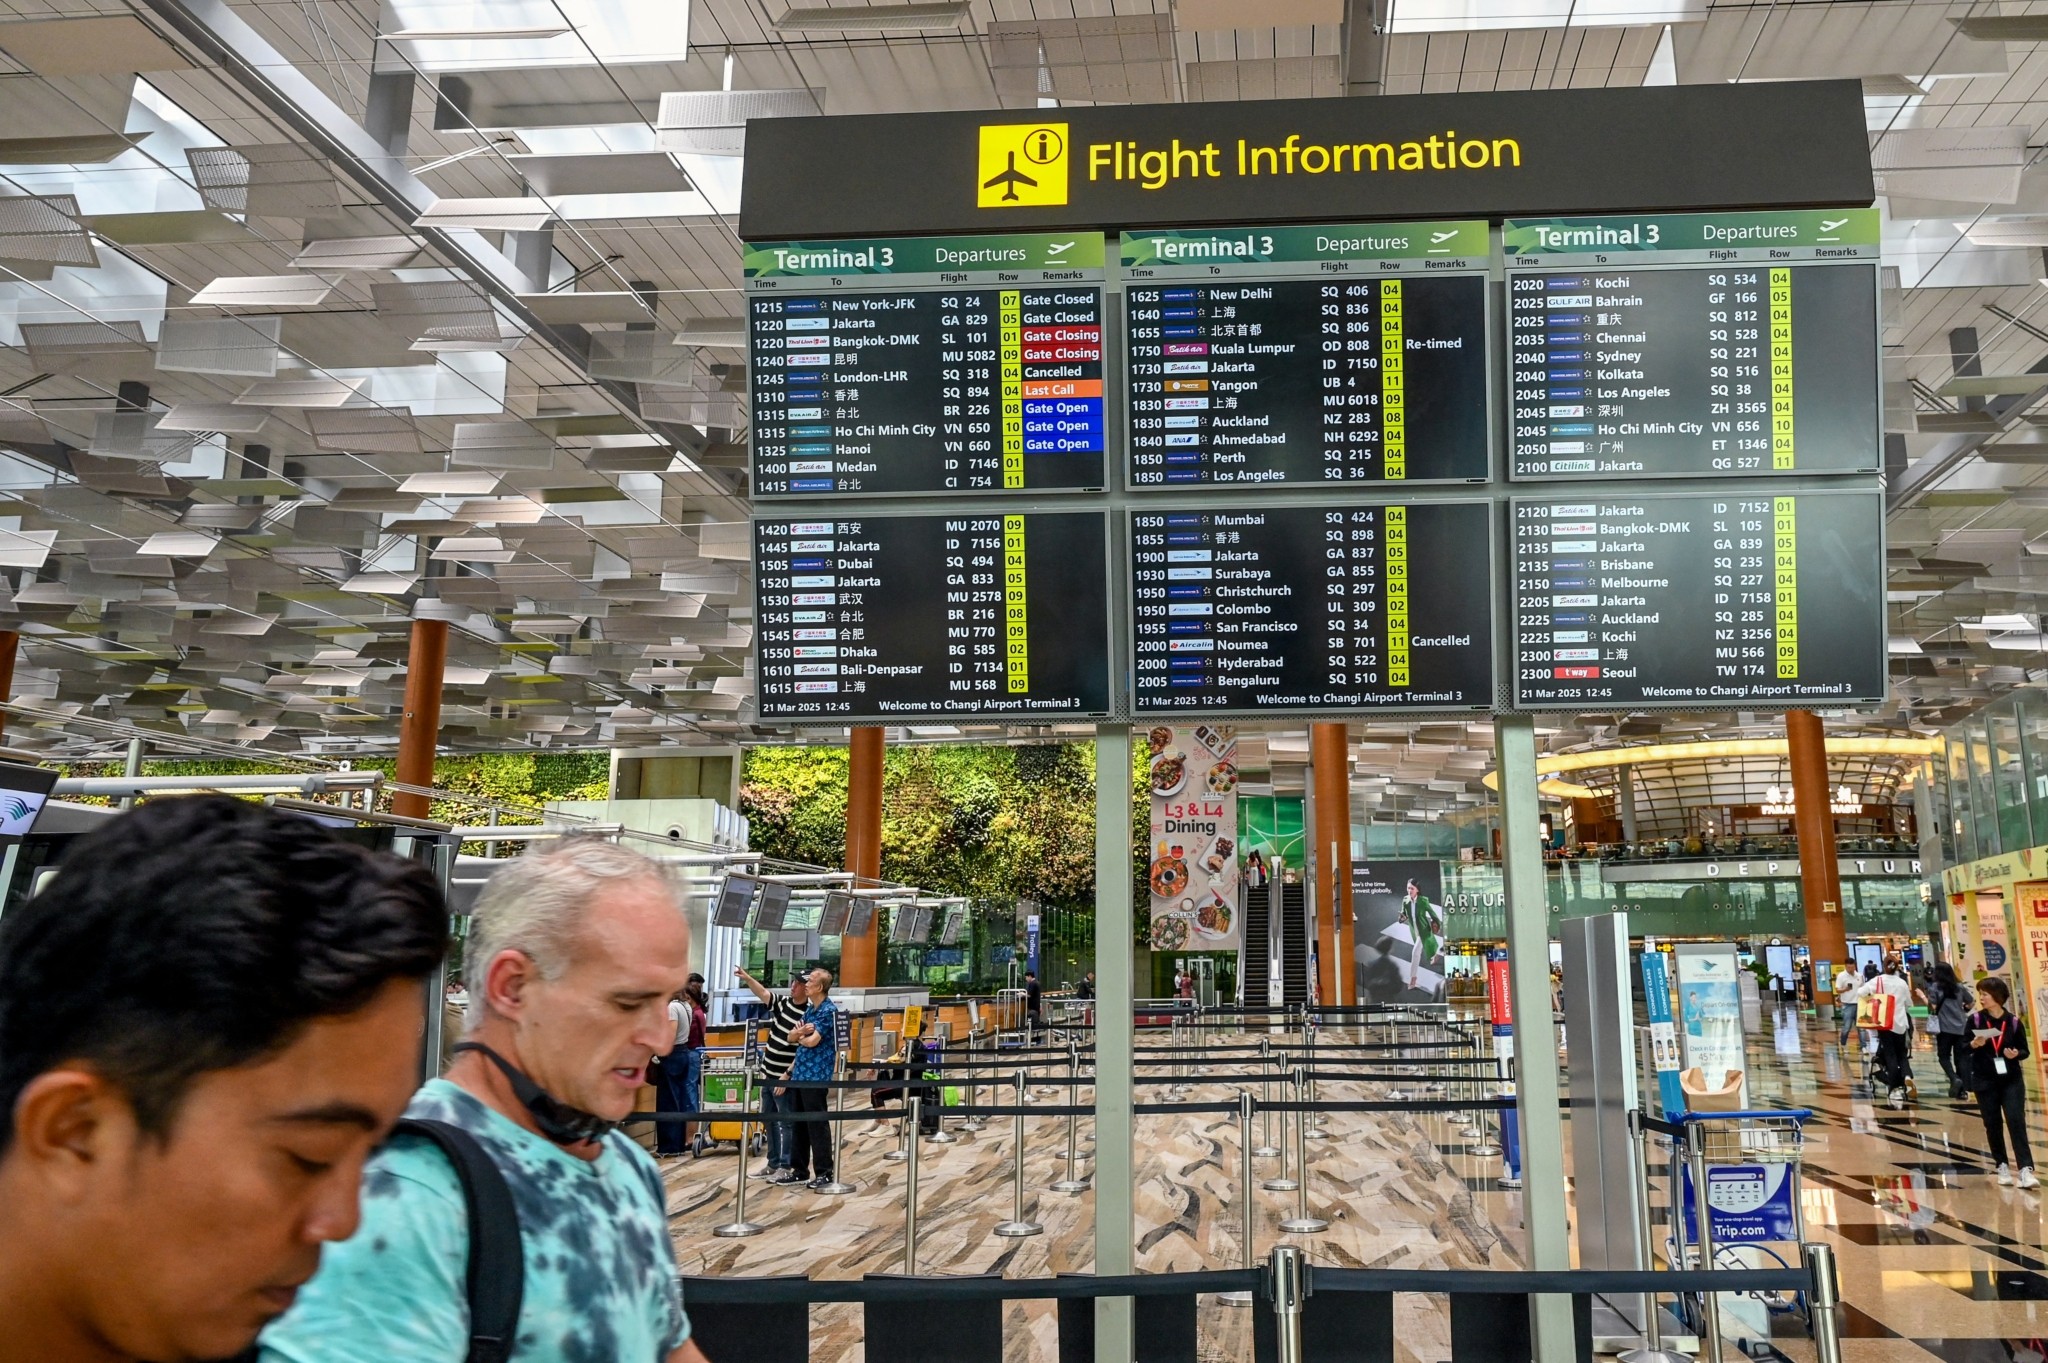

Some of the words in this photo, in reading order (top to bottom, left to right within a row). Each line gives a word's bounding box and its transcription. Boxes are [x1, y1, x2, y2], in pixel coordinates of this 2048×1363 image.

[1090, 140, 1220, 189] Flight
[1238, 131, 1520, 175] Information
[1536, 225, 1640, 247] Terminal
[1647, 225, 1659, 243] 3
[1704, 225, 1797, 242] Departures
[1151, 236, 1253, 258] Terminal
[1261, 236, 1273, 255] 3
[1317, 237, 1408, 254] Departures
[774, 247, 874, 269] Terminal
[881, 248, 893, 266] 3
[936, 248, 1026, 265] Departures
[1515, 257, 1538, 265] Time
[1709, 250, 1737, 260] Flight
[1816, 248, 1857, 256] Remarks
[1321, 261, 1348, 272] Flight
[1425, 259, 1466, 268] Remarks
[754, 280, 776, 288] Time
[941, 273, 967, 283] Flight
[1043, 271, 1083, 279] Remarks
[755, 303, 782, 313] 1215
[833, 301, 859, 310] New
[862, 299, 915, 310] York-JFK
[942, 298, 958, 308] SQ
[966, 297, 980, 307] 24
[1003, 296, 1016, 305] 07
[1023, 295, 1051, 305] Gate
[1054, 293, 1093, 304] Closed
[1514, 298, 1543, 308] 2025
[1596, 295, 1642, 306] Bahrain
[1709, 293, 1725, 303] GF
[1735, 292, 1757, 302] 166
[1773, 292, 1787, 301] 05
[1132, 346, 1160, 356] 1750
[1169, 345, 1189, 353] Batik
[1212, 343, 1244, 354] Kuala
[1249, 343, 1295, 355] Lumpur
[1323, 341, 1341, 351] OD
[1347, 340, 1369, 350] 808
[1385, 340, 1397, 349] 01
[1407, 338, 1461, 349] Re-timed
[757, 374, 784, 384] 1245
[834, 371, 908, 382] London-LHR
[943, 370, 960, 380] SQ
[968, 369, 989, 379] 318
[1004, 368, 1018, 377] 04
[1025, 366, 1081, 377] Cancelled
[757, 392, 785, 402] 1310
[835, 389, 859, 401] 香港
[943, 388, 960, 398] SQ
[968, 387, 989, 397] 894
[1005, 386, 1018, 396] 04
[1026, 386, 1049, 395] Last
[1052, 384, 1074, 394] Call
[758, 446, 785, 456] 1325
[836, 444, 870, 454] Hanoi
[945, 442, 962, 451] VN
[969, 441, 990, 451] 660
[1007, 440, 1020, 450] 10
[1027, 440, 1054, 449] Gate
[1058, 439, 1089, 451] Open
[1518, 462, 1547, 472] 2100
[1555, 461, 1590, 470] Citilink
[1599, 460, 1643, 471] Jakarta
[1712, 458, 1731, 469] QG
[1738, 457, 1760, 468] 527
[1777, 457, 1789, 466] 11
[760, 543, 787, 553] 1445
[837, 541, 880, 551] Jakarta
[947, 539, 959, 549] ID
[971, 538, 1000, 548] 7156
[1008, 538, 1020, 547] 01
[1138, 641, 1166, 651] 2000
[1218, 640, 1268, 650] Noumea
[1329, 638, 1344, 648] SB
[1354, 637, 1374, 647] 701
[1392, 637, 1403, 646] 11
[1412, 635, 1470, 646] Cancelled
[1521, 669, 1551, 679] 2300
[1566, 667, 1588, 678] t'way
[1603, 667, 1636, 678] Seoul
[1716, 666, 1737, 675] TW
[1743, 665, 1765, 675] 174
[1780, 665, 1794, 674] 02
[774, 703, 791, 712] Mar
[798, 703, 820, 711] 2025
[879, 701, 927, 710] Welcome
[930, 701, 941, 709] to
[944, 700, 980, 711] Changi
[984, 699, 1021, 710] Airport
[1025, 698, 1070, 708] Terminal
[1074, 698, 1080, 707] 3
[1165, 804, 1183, 818] L3
[1188, 803, 1199, 816] &
[1205, 803, 1223, 817] L4
[1166, 819, 1216, 836] Dining
[1660, 987, 1668, 1015] ECONOMY
[1715, 1225, 1765, 1238] Trip.com
